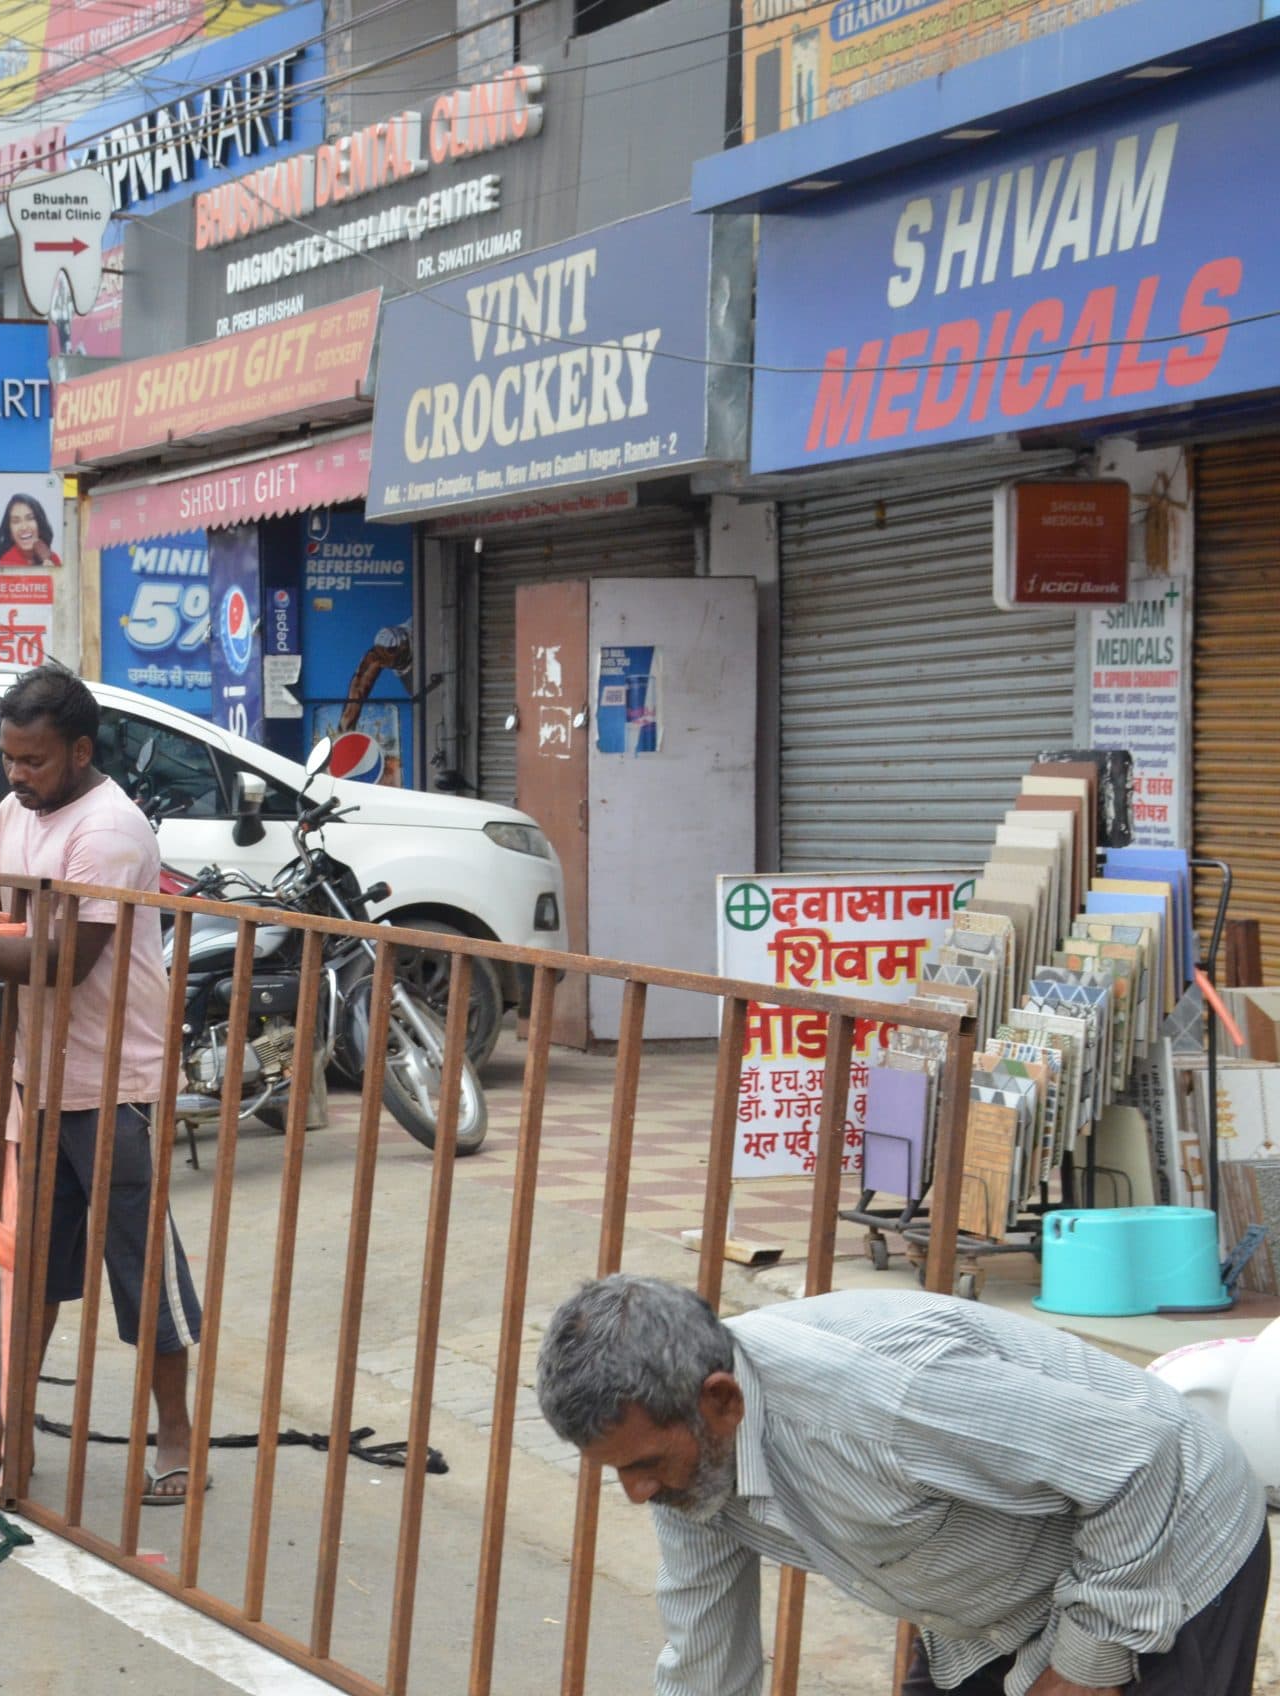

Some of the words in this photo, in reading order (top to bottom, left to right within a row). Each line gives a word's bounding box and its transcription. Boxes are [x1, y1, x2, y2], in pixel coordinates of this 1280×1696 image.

[96, 54, 297, 213] APNAMART
[195, 155, 314, 250] BHUSHAN
[316, 110, 428, 207] DENTAL
[430, 65, 544, 165] CLINIC
[21, 209, 62, 221] Dental
[65, 208, 102, 221] Clinic
[33, 193, 88, 205] Bhushan
[887, 122, 1179, 309] SHIVAM
[226, 234, 320, 294] DIAGNOSTIC
[417, 174, 500, 233] CENTRE
[417, 258, 436, 280] DR.
[438, 242, 475, 274] SWATI
[475, 229, 521, 261] KUMAR
[216, 318, 232, 338] DR.
[232, 309, 257, 333] PREM
[257, 295, 304, 325] BHUSHAN
[466, 248, 597, 361] VINIT
[134, 345, 239, 417] SHRUTI
[244, 322, 317, 388] GIFT
[803, 256, 1243, 453] MEDICALS
[56, 378, 122, 431] CHUSKI
[404, 328, 661, 464] CROCKERY
[624, 435, 660, 464] Ranchi
[669, 432, 677, 455] 2
[180, 476, 247, 518] SHRUTI
[254, 463, 298, 503] GIFT
[1040, 515, 1105, 527] MEDICALS
[131, 547, 209, 576] MINI
[306, 560, 405, 575] REFRESHING
[322, 543, 375, 558] ENJOY
[8, 583, 48, 593] CENTRE
[306, 576, 351, 590] PEPSI
[1040, 581, 1079, 593] ICICI
[1080, 581, 1121, 593] Bank
[274, 608, 289, 652] pepsi
[1102, 600, 1166, 629] SHIVAM
[1096, 636, 1173, 666] MEDICALS
[771, 884, 955, 927] दवाखाना
[766, 928, 928, 987] शिवम
[738, 1066, 765, 1093] डॉ.
[738, 1096, 767, 1122] डॉ.
[743, 1133, 779, 1160] भूत
[783, 1120, 813, 1157] पूर्व
